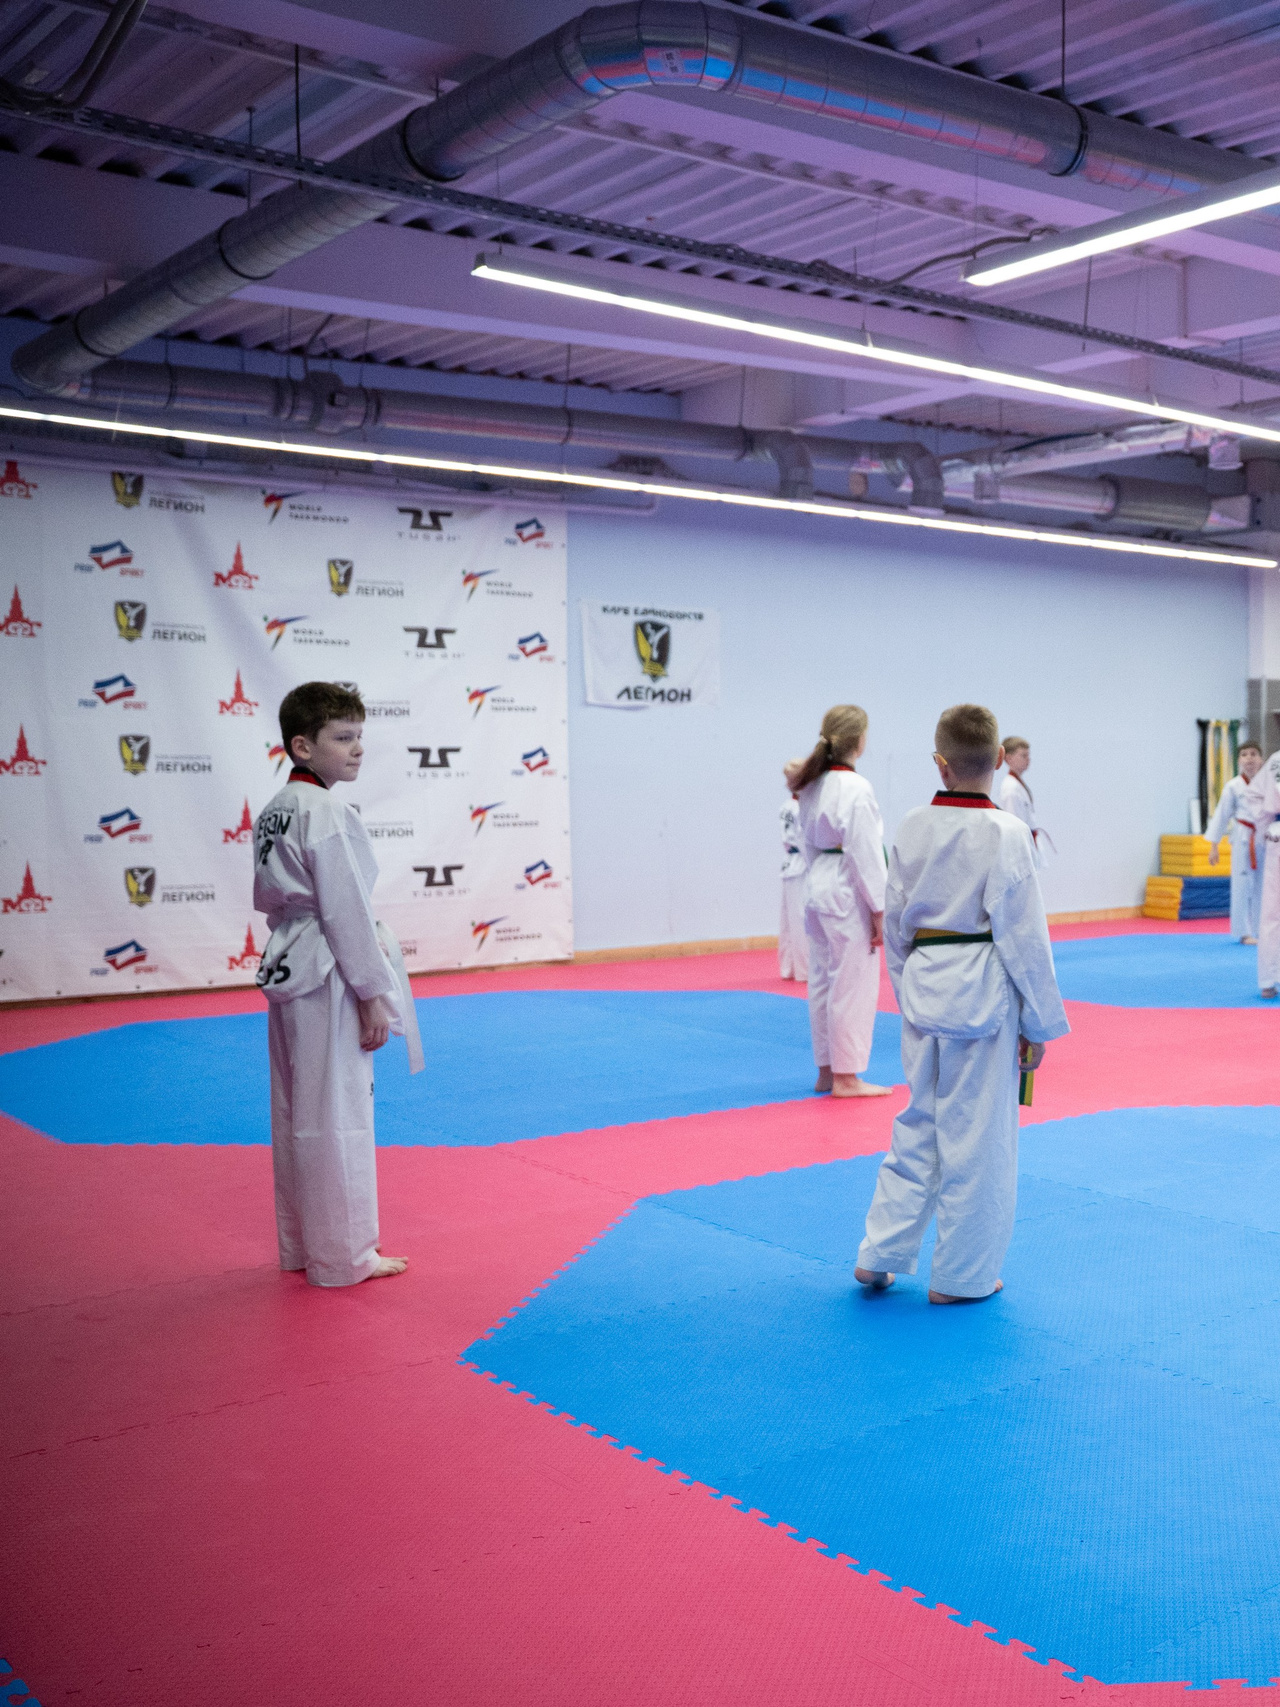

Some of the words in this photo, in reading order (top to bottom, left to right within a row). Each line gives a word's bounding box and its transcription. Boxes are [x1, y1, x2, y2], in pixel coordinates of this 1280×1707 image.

[149, 497, 205, 513] ЛЕГИОН
[355, 585, 404, 597] ЛЕГИОН
[152, 629, 206, 643] ЛЕГИОН
[617, 686, 692, 702] ЛЕГИОН
[155, 761, 212, 773] ЛЕГИОН
[161, 891, 215, 902] ЛЕГИОН
